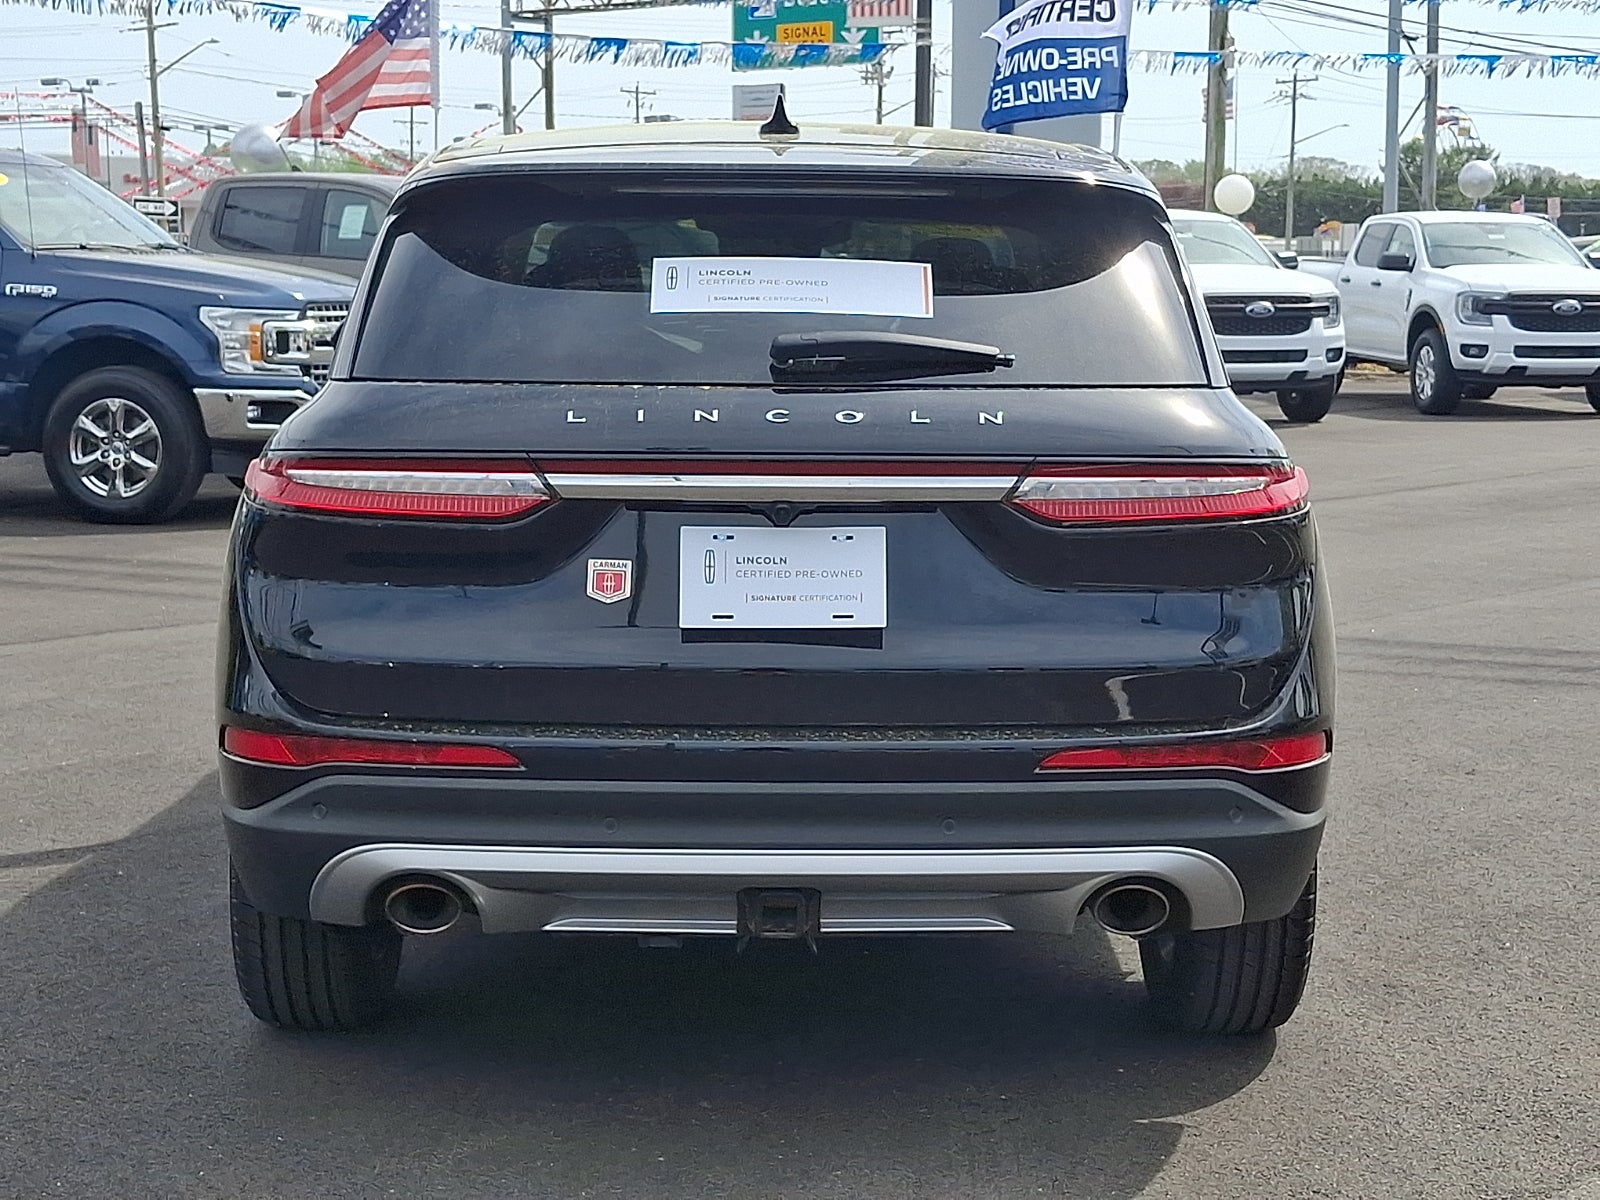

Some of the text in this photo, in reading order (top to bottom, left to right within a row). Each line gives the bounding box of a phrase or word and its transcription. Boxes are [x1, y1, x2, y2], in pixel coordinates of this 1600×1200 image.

[783, 26, 826, 39] SIGNAL
[698, 278, 829, 287] CERTIFIED PRE-OWNED
[565, 409, 1005, 425] LINCOLN
[593, 561, 627, 569] CARMAN
[735, 556, 788, 565] LINCOLN
[735, 569, 863, 579] CERTIFIED PRE-OWNED
[751, 594, 858, 602] SIGNATURE CERTIFICATION
